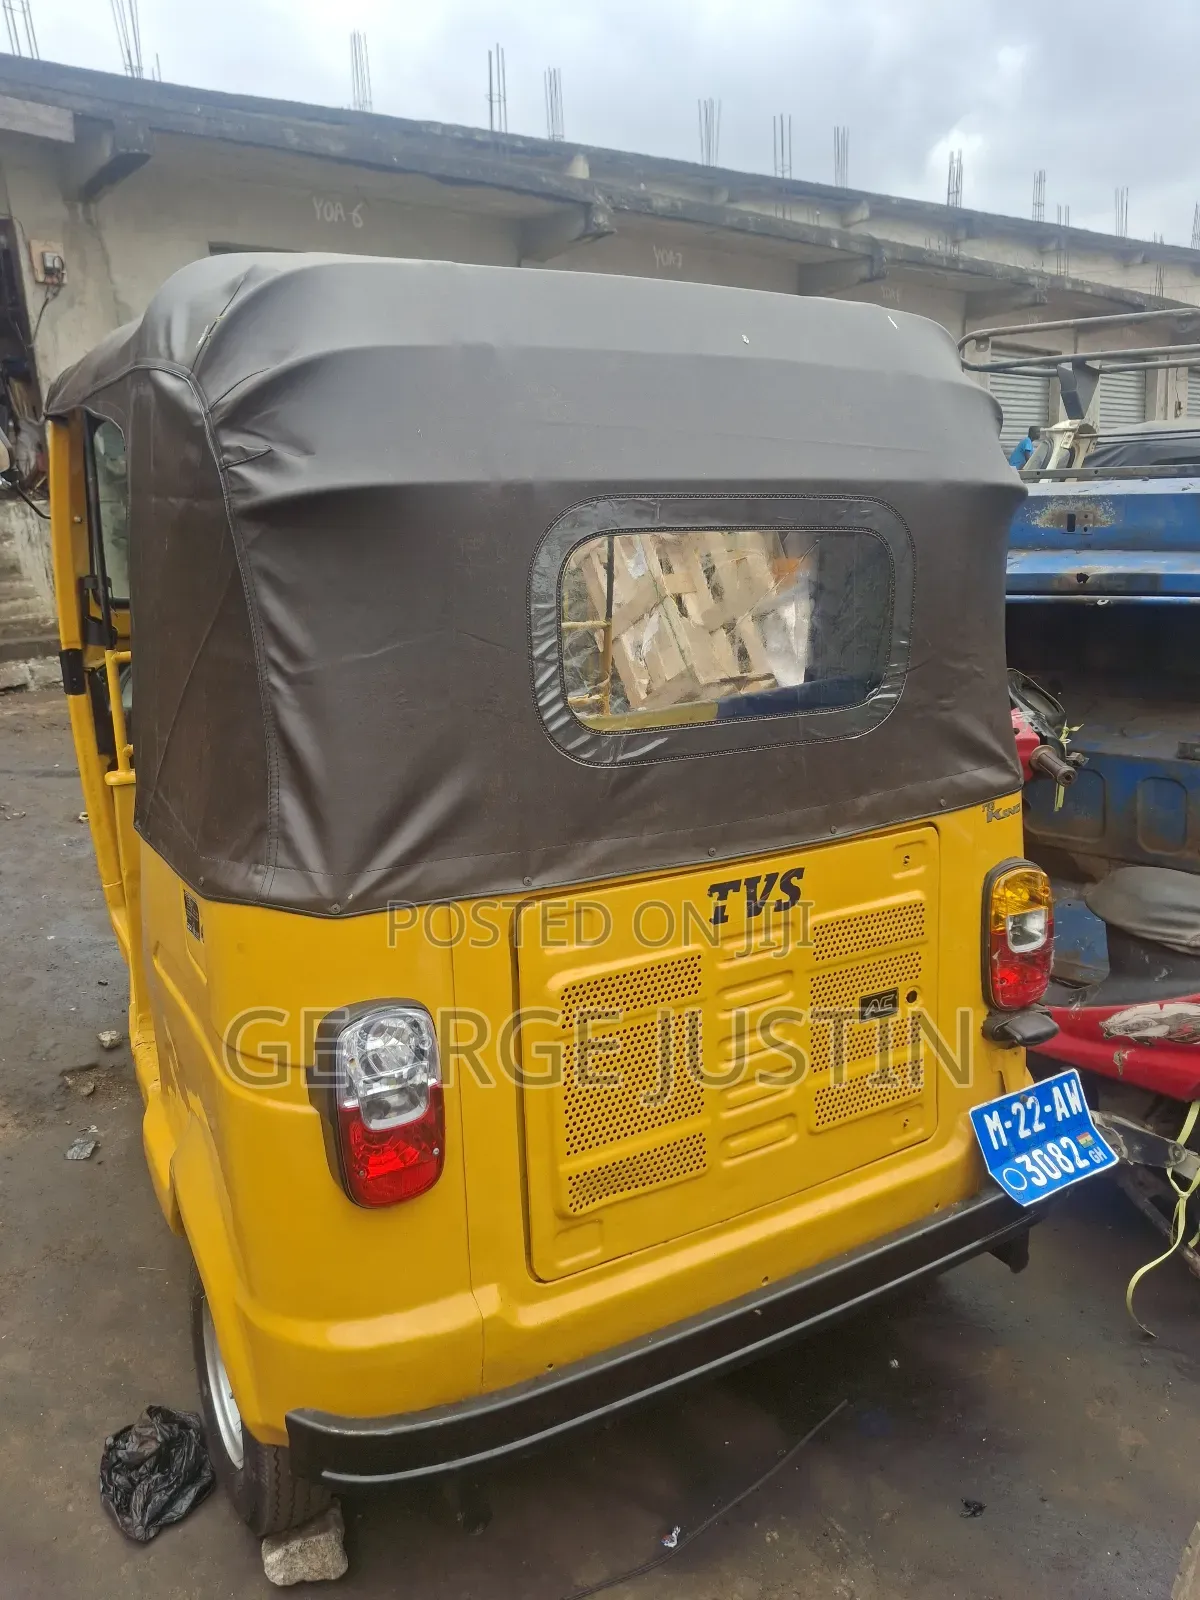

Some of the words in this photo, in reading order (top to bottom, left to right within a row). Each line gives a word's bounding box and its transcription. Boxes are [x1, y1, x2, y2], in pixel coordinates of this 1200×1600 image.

[707, 867, 805, 925] TVS
[983, 1079, 1083, 1151] M-22-AW
[1014, 1136, 1091, 1187] 3082
[1088, 1146, 1108, 1164] GH
